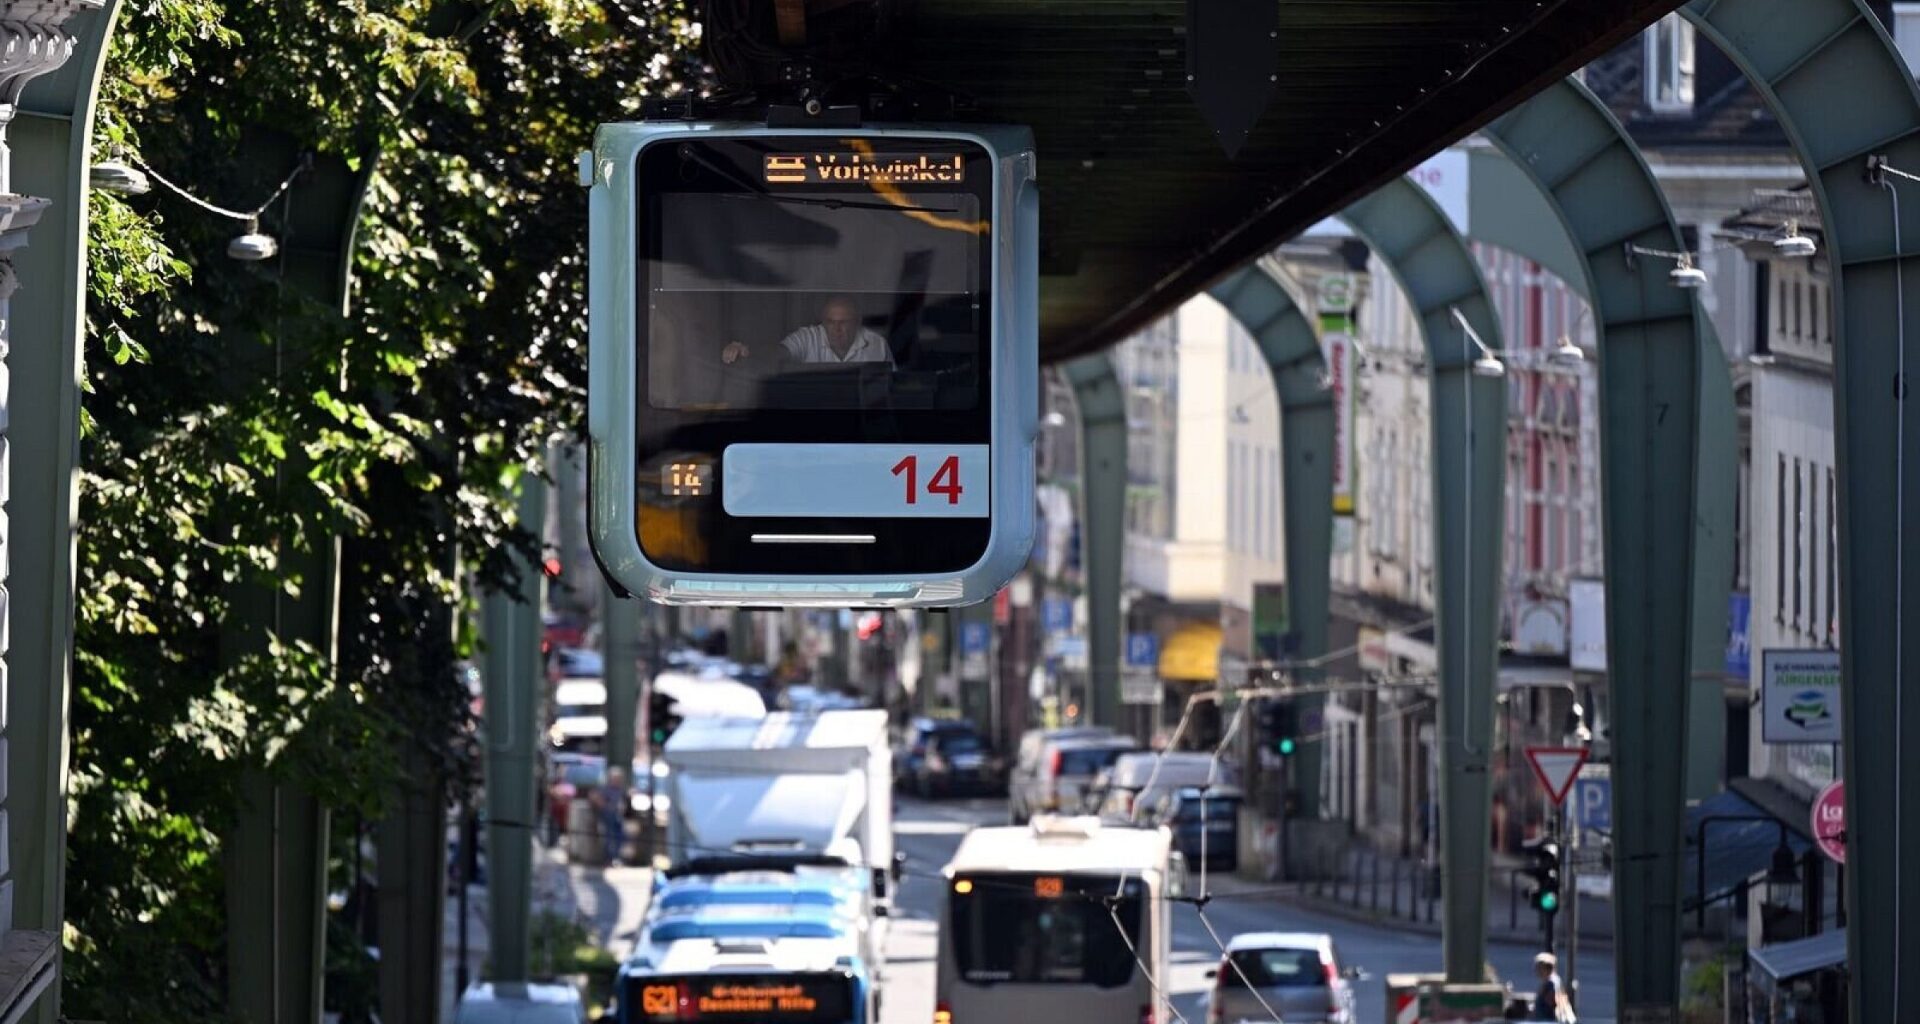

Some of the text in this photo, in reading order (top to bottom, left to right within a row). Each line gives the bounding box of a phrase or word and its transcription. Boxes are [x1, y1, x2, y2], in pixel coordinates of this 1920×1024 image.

[671, 464, 701, 495] 14
[891, 456, 963, 504] 14
[1583, 783, 1603, 820] P
